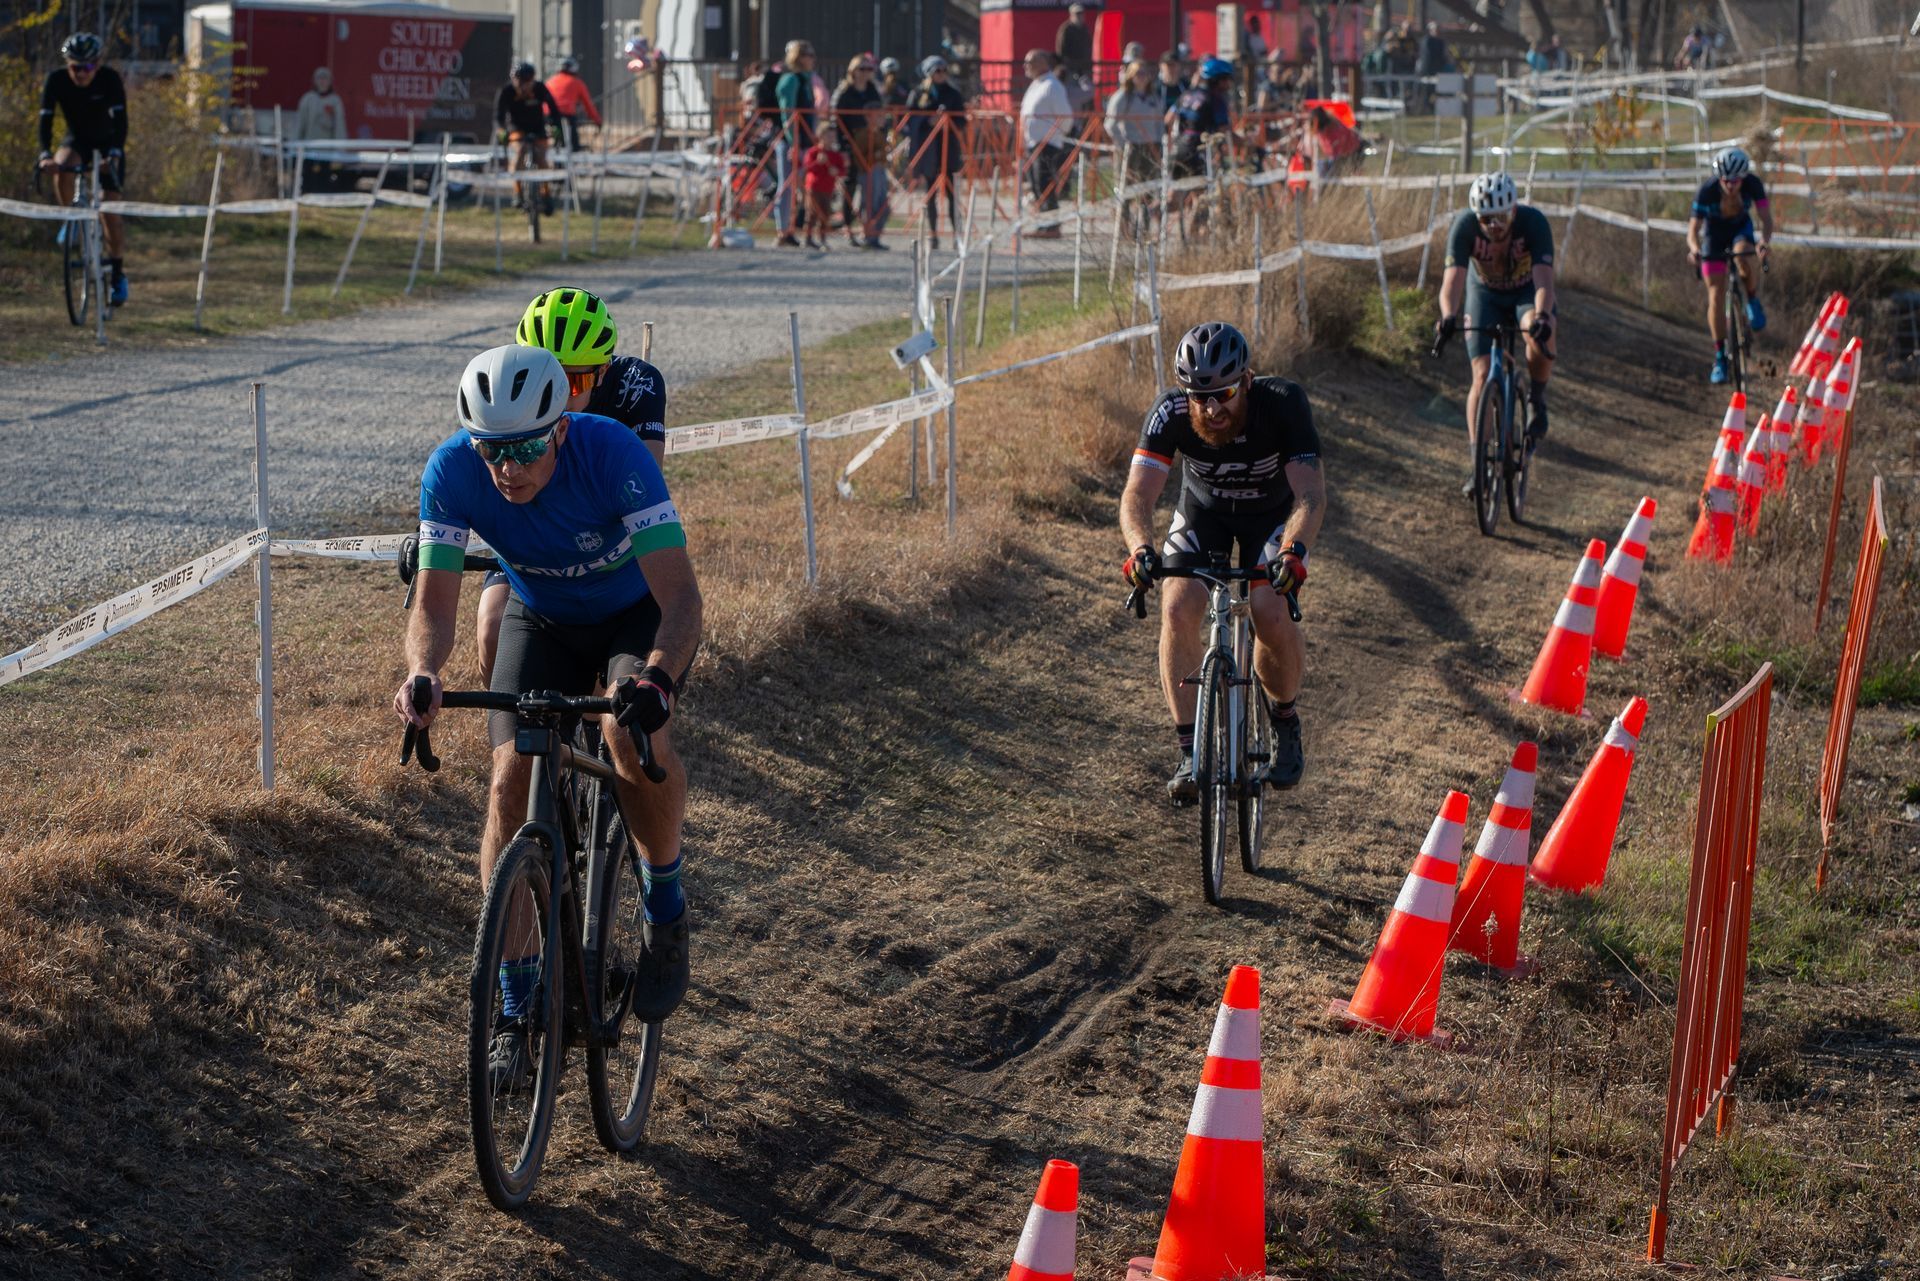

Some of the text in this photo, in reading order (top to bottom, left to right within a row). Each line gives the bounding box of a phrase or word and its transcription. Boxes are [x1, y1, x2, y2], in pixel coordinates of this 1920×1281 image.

[391, 20, 453, 47] SOUTH
[378, 47, 463, 74] CHICAGO
[371, 73, 470, 100] WHEELMEN
